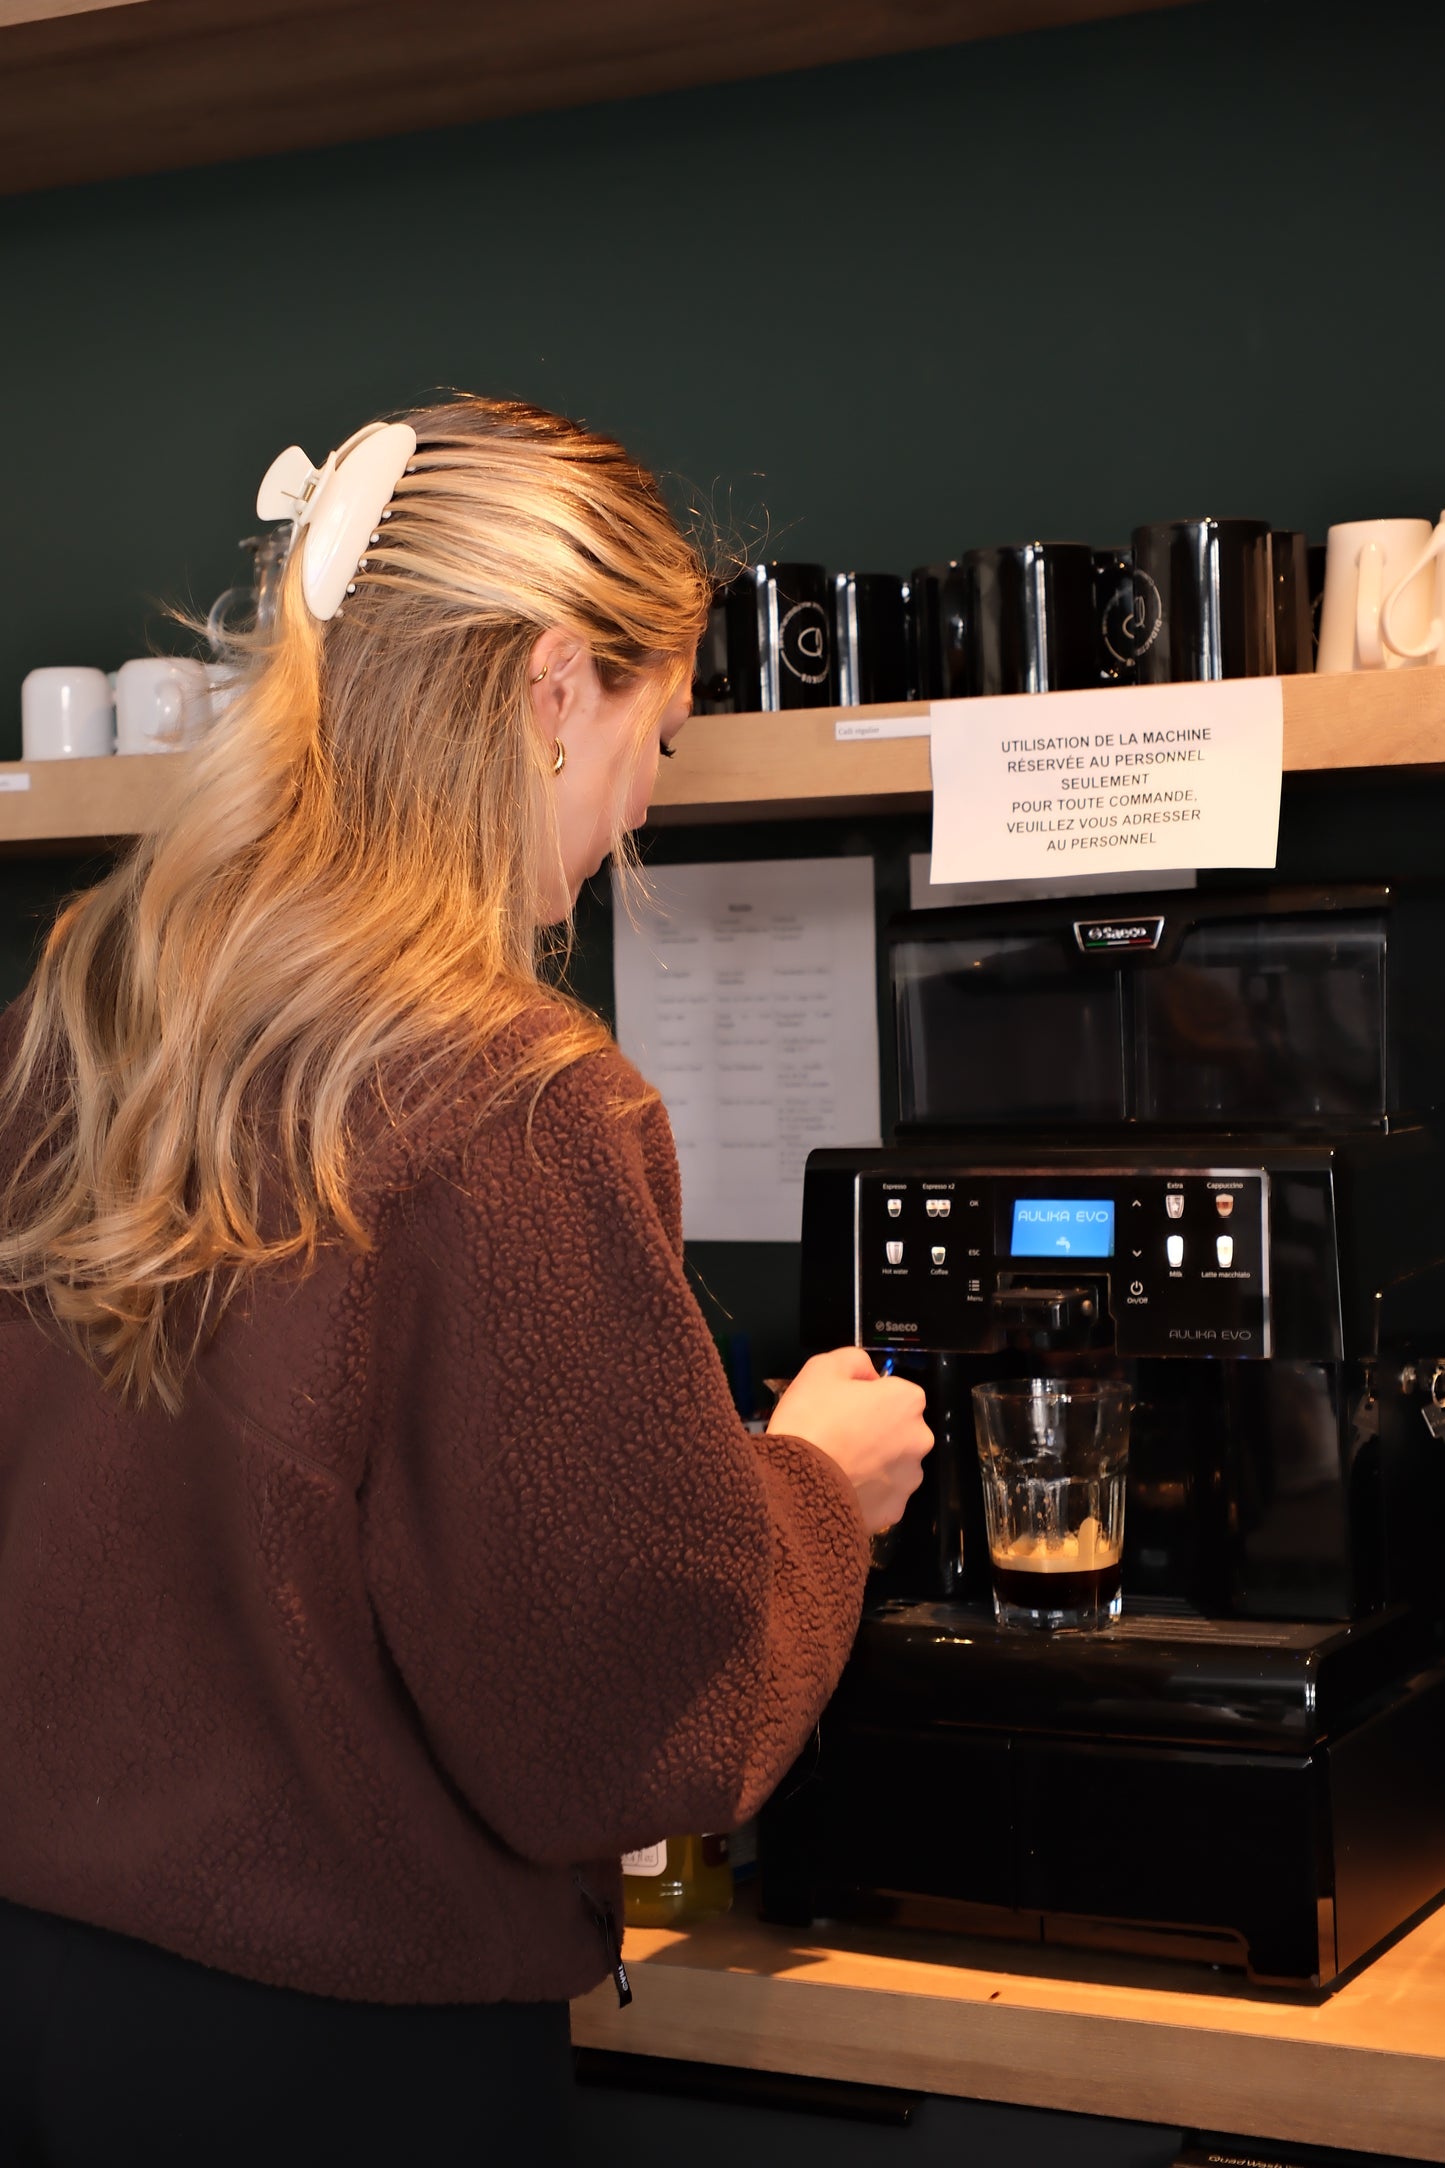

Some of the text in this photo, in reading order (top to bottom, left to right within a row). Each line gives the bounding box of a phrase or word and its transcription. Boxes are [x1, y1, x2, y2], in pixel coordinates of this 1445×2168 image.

[1001, 728, 1212, 753] UTILISATION DE LA MACHINE
[1007, 750, 1205, 773] RÉSERVÉE AU PERSONNEL
[1061, 773, 1150, 790] SEULEMENT
[1012, 800, 1053, 813] POUR
[1057, 796, 1104, 811] TOUTE
[1006, 809, 1201, 833] VEUILLEZ VOUS ADRESSER
[1046, 832, 1157, 852] AU PERSONNEL
[1102, 926, 1147, 939] Saeco
[1206, 1182, 1244, 1190] Cappuccino
[1018, 1210, 1109, 1223] AULIKA EVO
[885, 1321, 918, 1332] Saeco
[1169, 1329, 1251, 1340] AULIKA EVO
